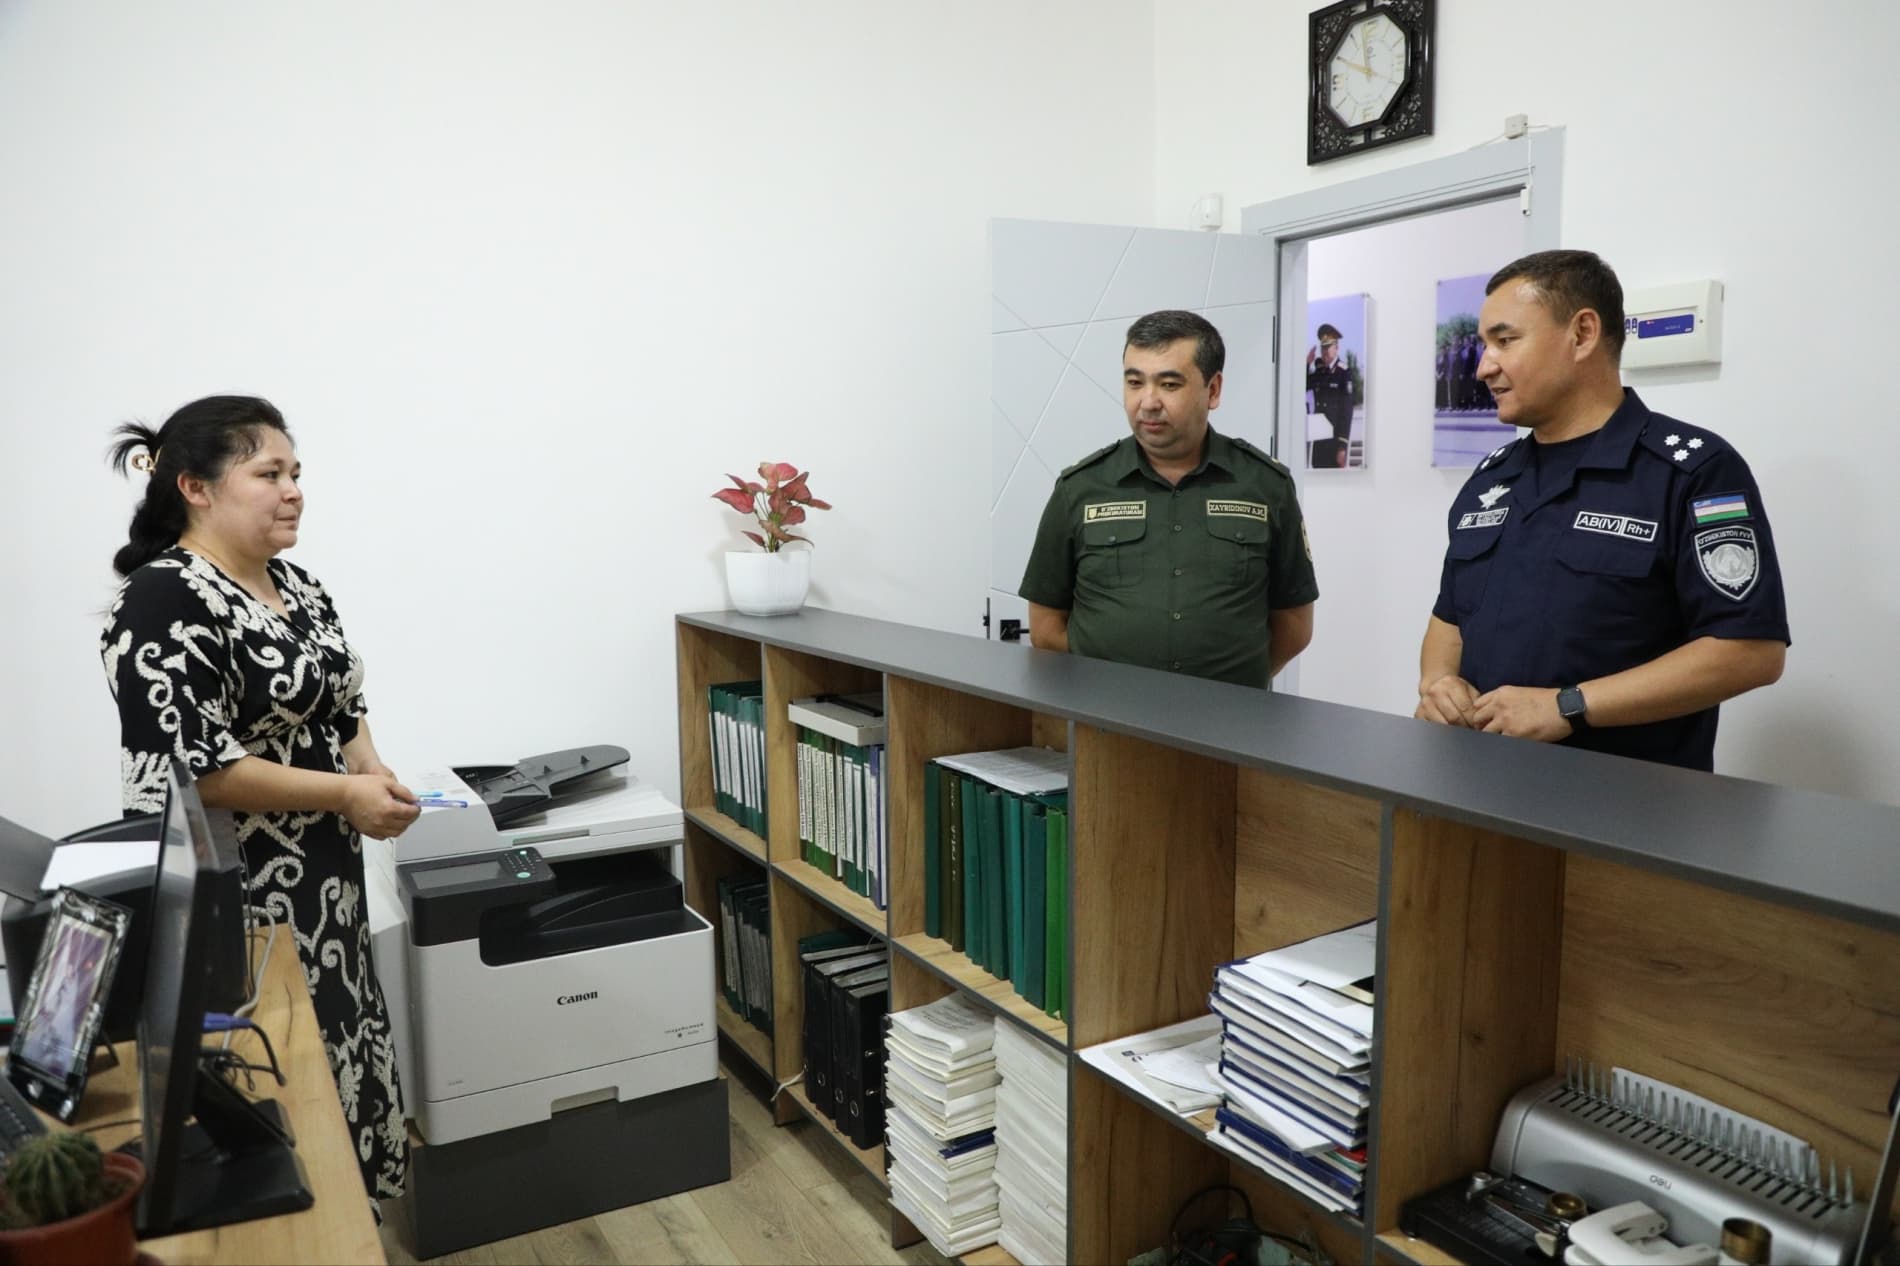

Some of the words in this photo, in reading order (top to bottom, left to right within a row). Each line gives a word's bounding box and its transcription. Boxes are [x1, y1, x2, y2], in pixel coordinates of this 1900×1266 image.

[1578, 515, 1621, 532] AB(IV)
[1626, 523, 1651, 536] Rh+
[556, 991, 599, 1006] Canon
